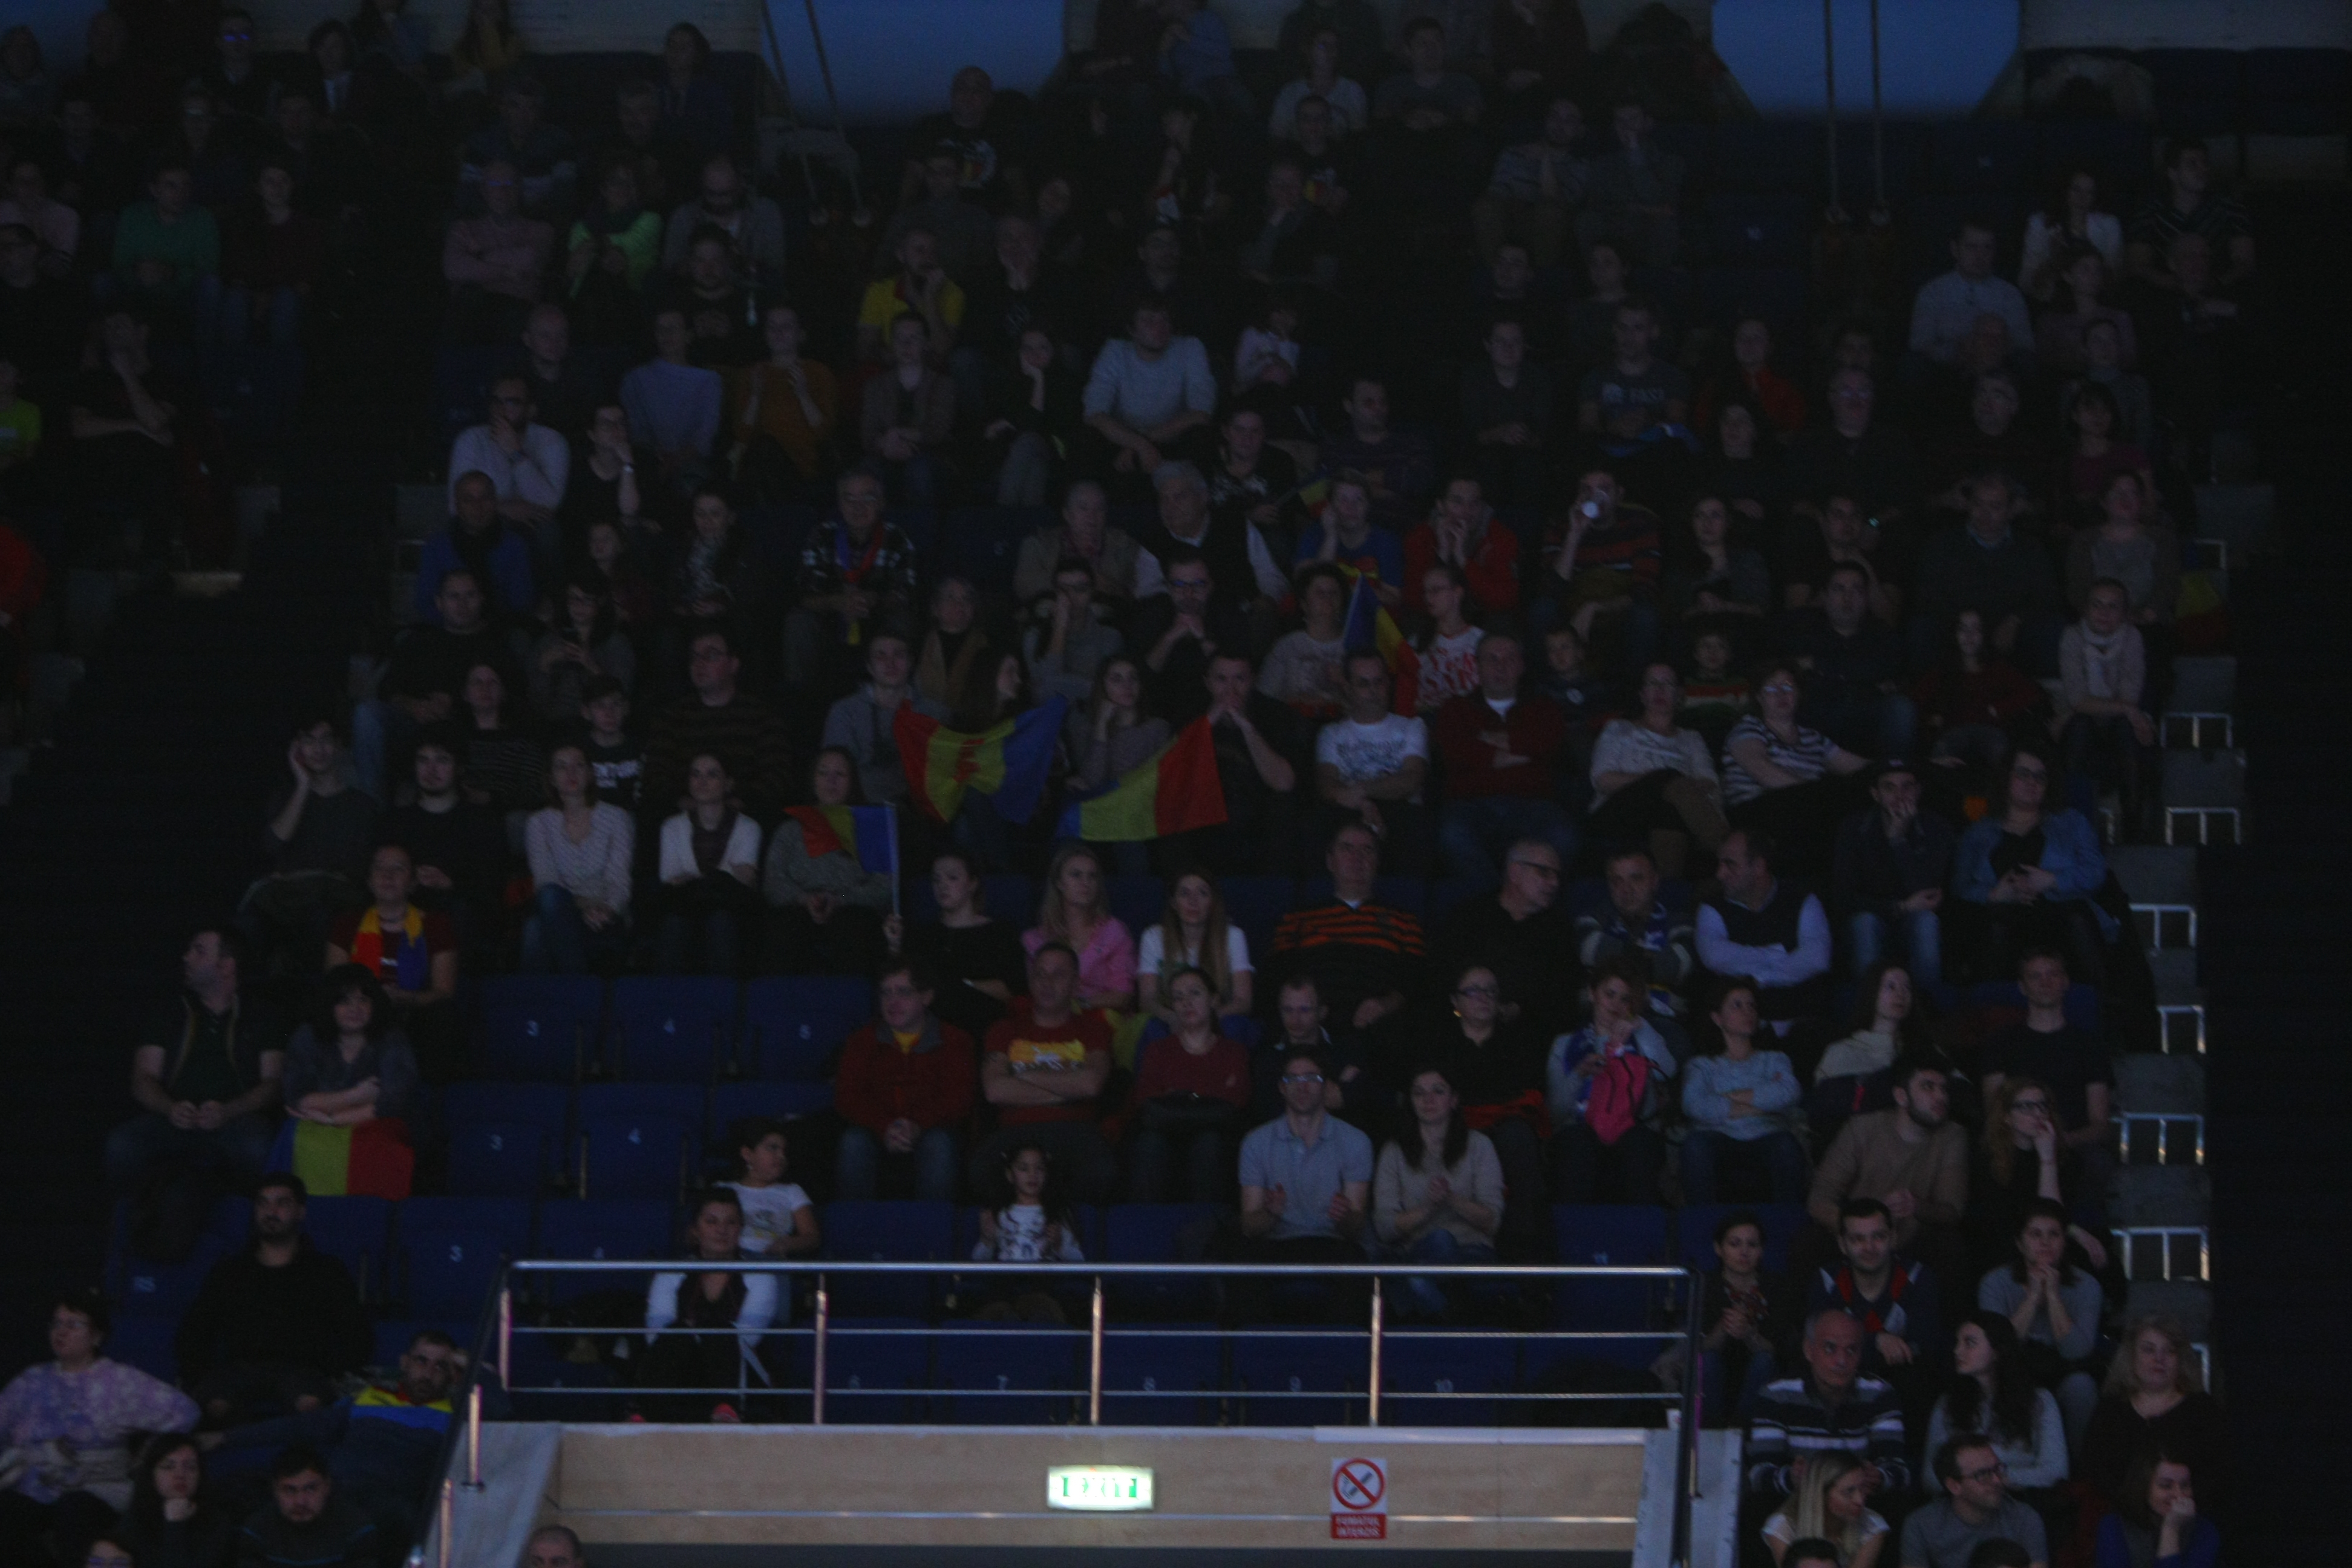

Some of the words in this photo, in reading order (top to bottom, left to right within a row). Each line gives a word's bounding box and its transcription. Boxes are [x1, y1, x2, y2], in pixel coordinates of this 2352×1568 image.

[526, 1019, 540, 1037] 3
[489, 1133, 503, 1151] 3
[449, 1245, 463, 1263] 3
